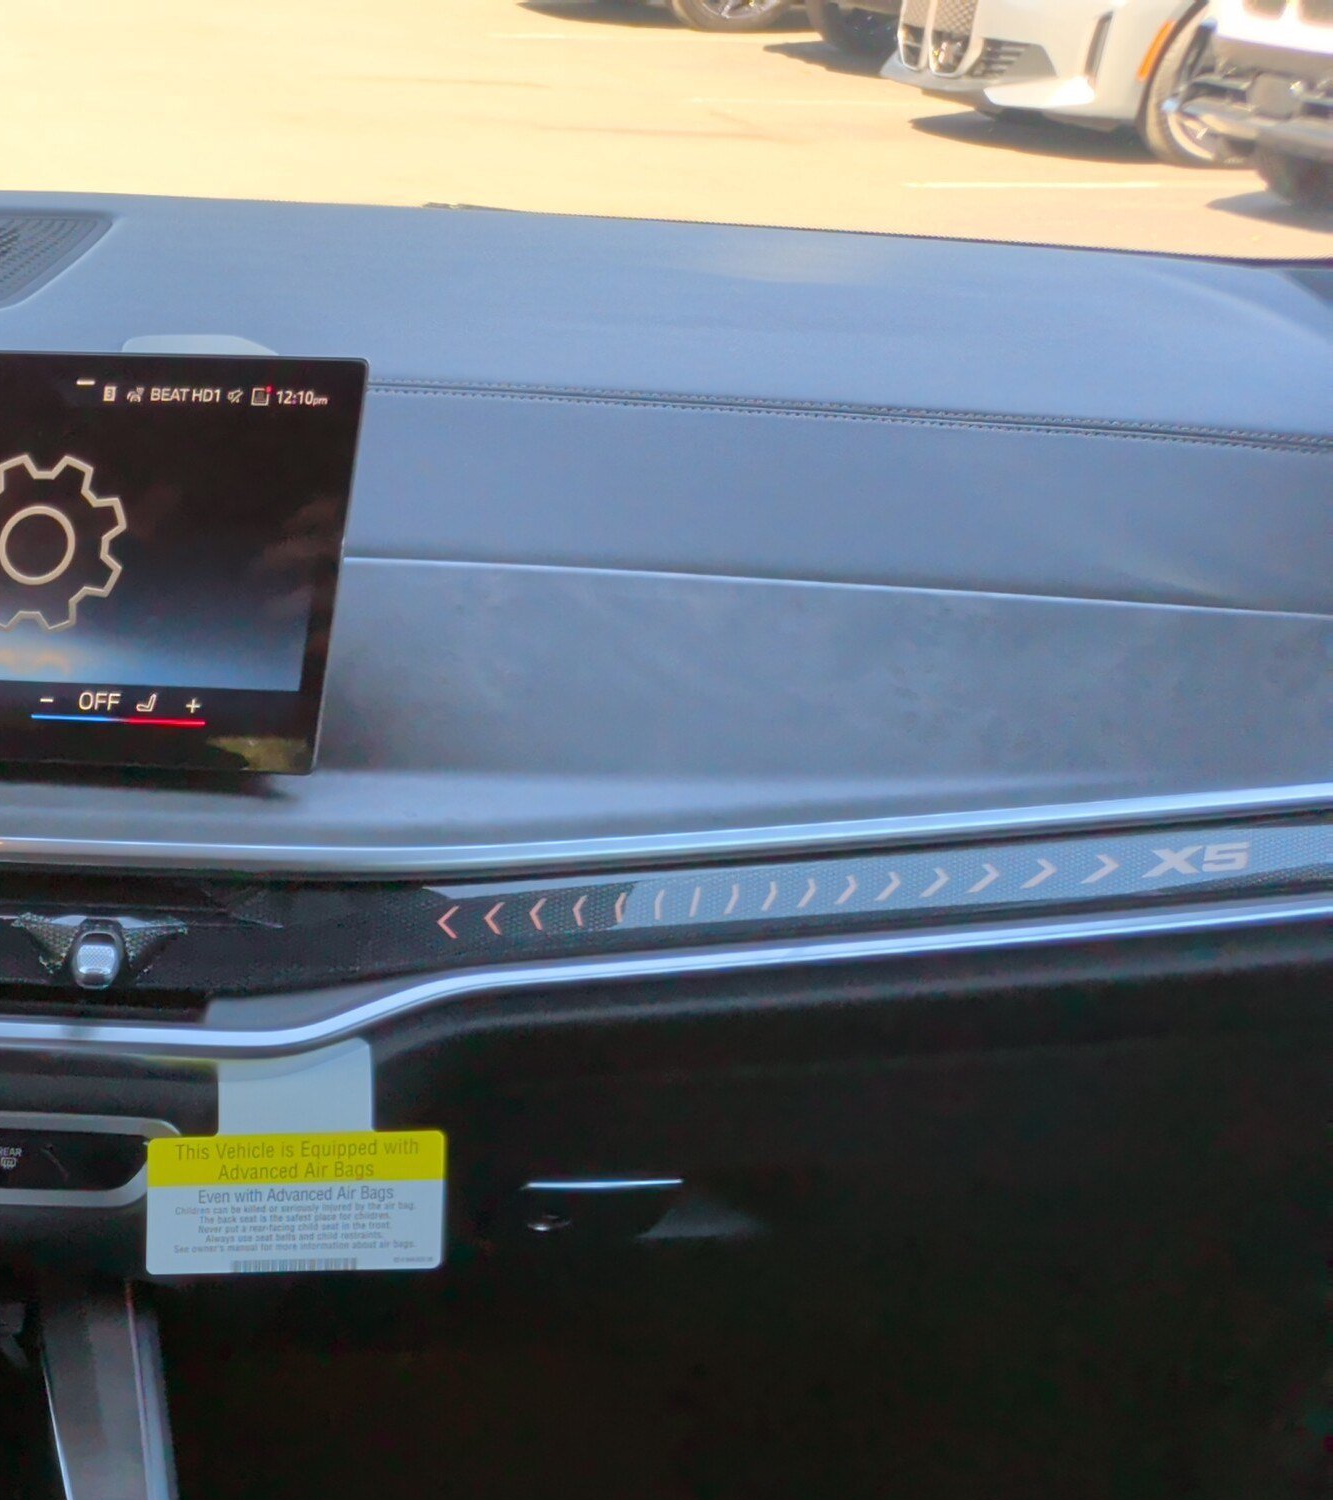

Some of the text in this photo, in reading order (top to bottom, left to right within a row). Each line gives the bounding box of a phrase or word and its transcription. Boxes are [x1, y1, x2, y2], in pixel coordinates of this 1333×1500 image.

[150, 387, 221, 402] BEAT HD1
[78, 691, 121, 711] OFF
[1142, 842, 1251, 879] X5
[175, 1138, 419, 1164] This Vehicle is Equipped with
[218, 1161, 375, 1181] Advanced Air Bags
[198, 1186, 394, 1204] Even with Advanced Air Bags
[175, 1206, 211, 1216] Children
[231, 1206, 241, 1214] be
[243, 1205, 266, 1213] killed
[281, 1204, 319, 1214] seriously
[322, 1203, 352, 1213] injured
[355, 1202, 365, 1212] by
[367, 1202, 380, 1211] the
[384, 1201, 395, 1210] air
[199, 1216, 214, 1224] The
[217, 1215, 236, 1223] back
[240, 1215, 257, 1223] seat
[270, 1214, 283, 1222] the
[287, 1213, 311, 1222] safest
[314, 1213, 337, 1223] place
[339, 1212, 351, 1221] for
[198, 1225, 222, 1233] Never
[225, 1225, 239, 1234] put
[298, 1223, 319, 1232] child
[352, 1222, 366, 1230] the
[205, 1235, 235, 1244] Always
[299, 1232, 314, 1240] and
[317, 1232, 338, 1240] child
[299, 1241, 350, 1250] information
[352, 1241, 377, 1249] about
[379, 1240, 390, 1248] air
